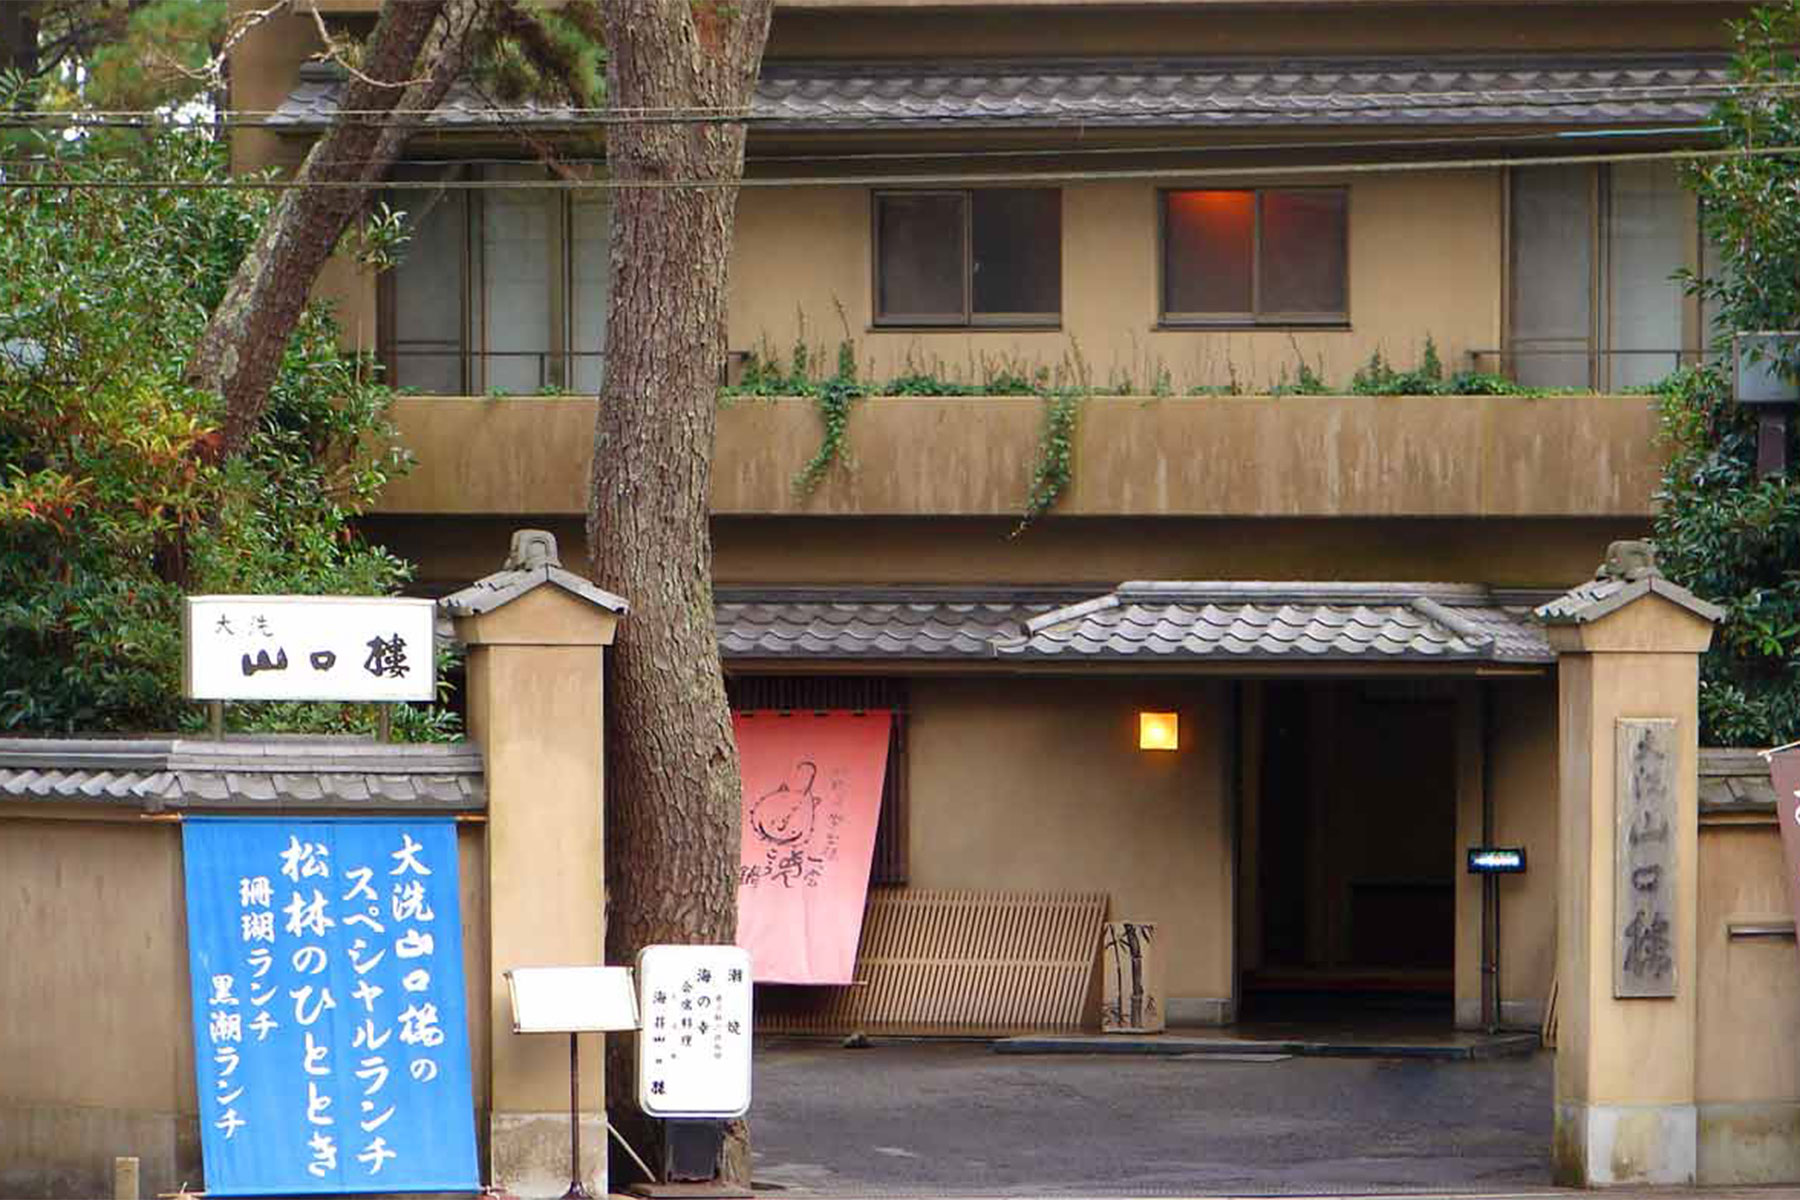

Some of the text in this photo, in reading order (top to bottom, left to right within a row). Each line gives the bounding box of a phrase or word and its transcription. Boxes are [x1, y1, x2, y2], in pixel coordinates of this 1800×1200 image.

[215, 613, 274, 638] 大洗
[239, 875, 279, 1042] 珊瑚ランチ
[280, 835, 339, 1178] 松林のひととき
[342, 866, 397, 1176] スペシャルランチ
[208, 973, 247, 1139] 黒潮ランチ
